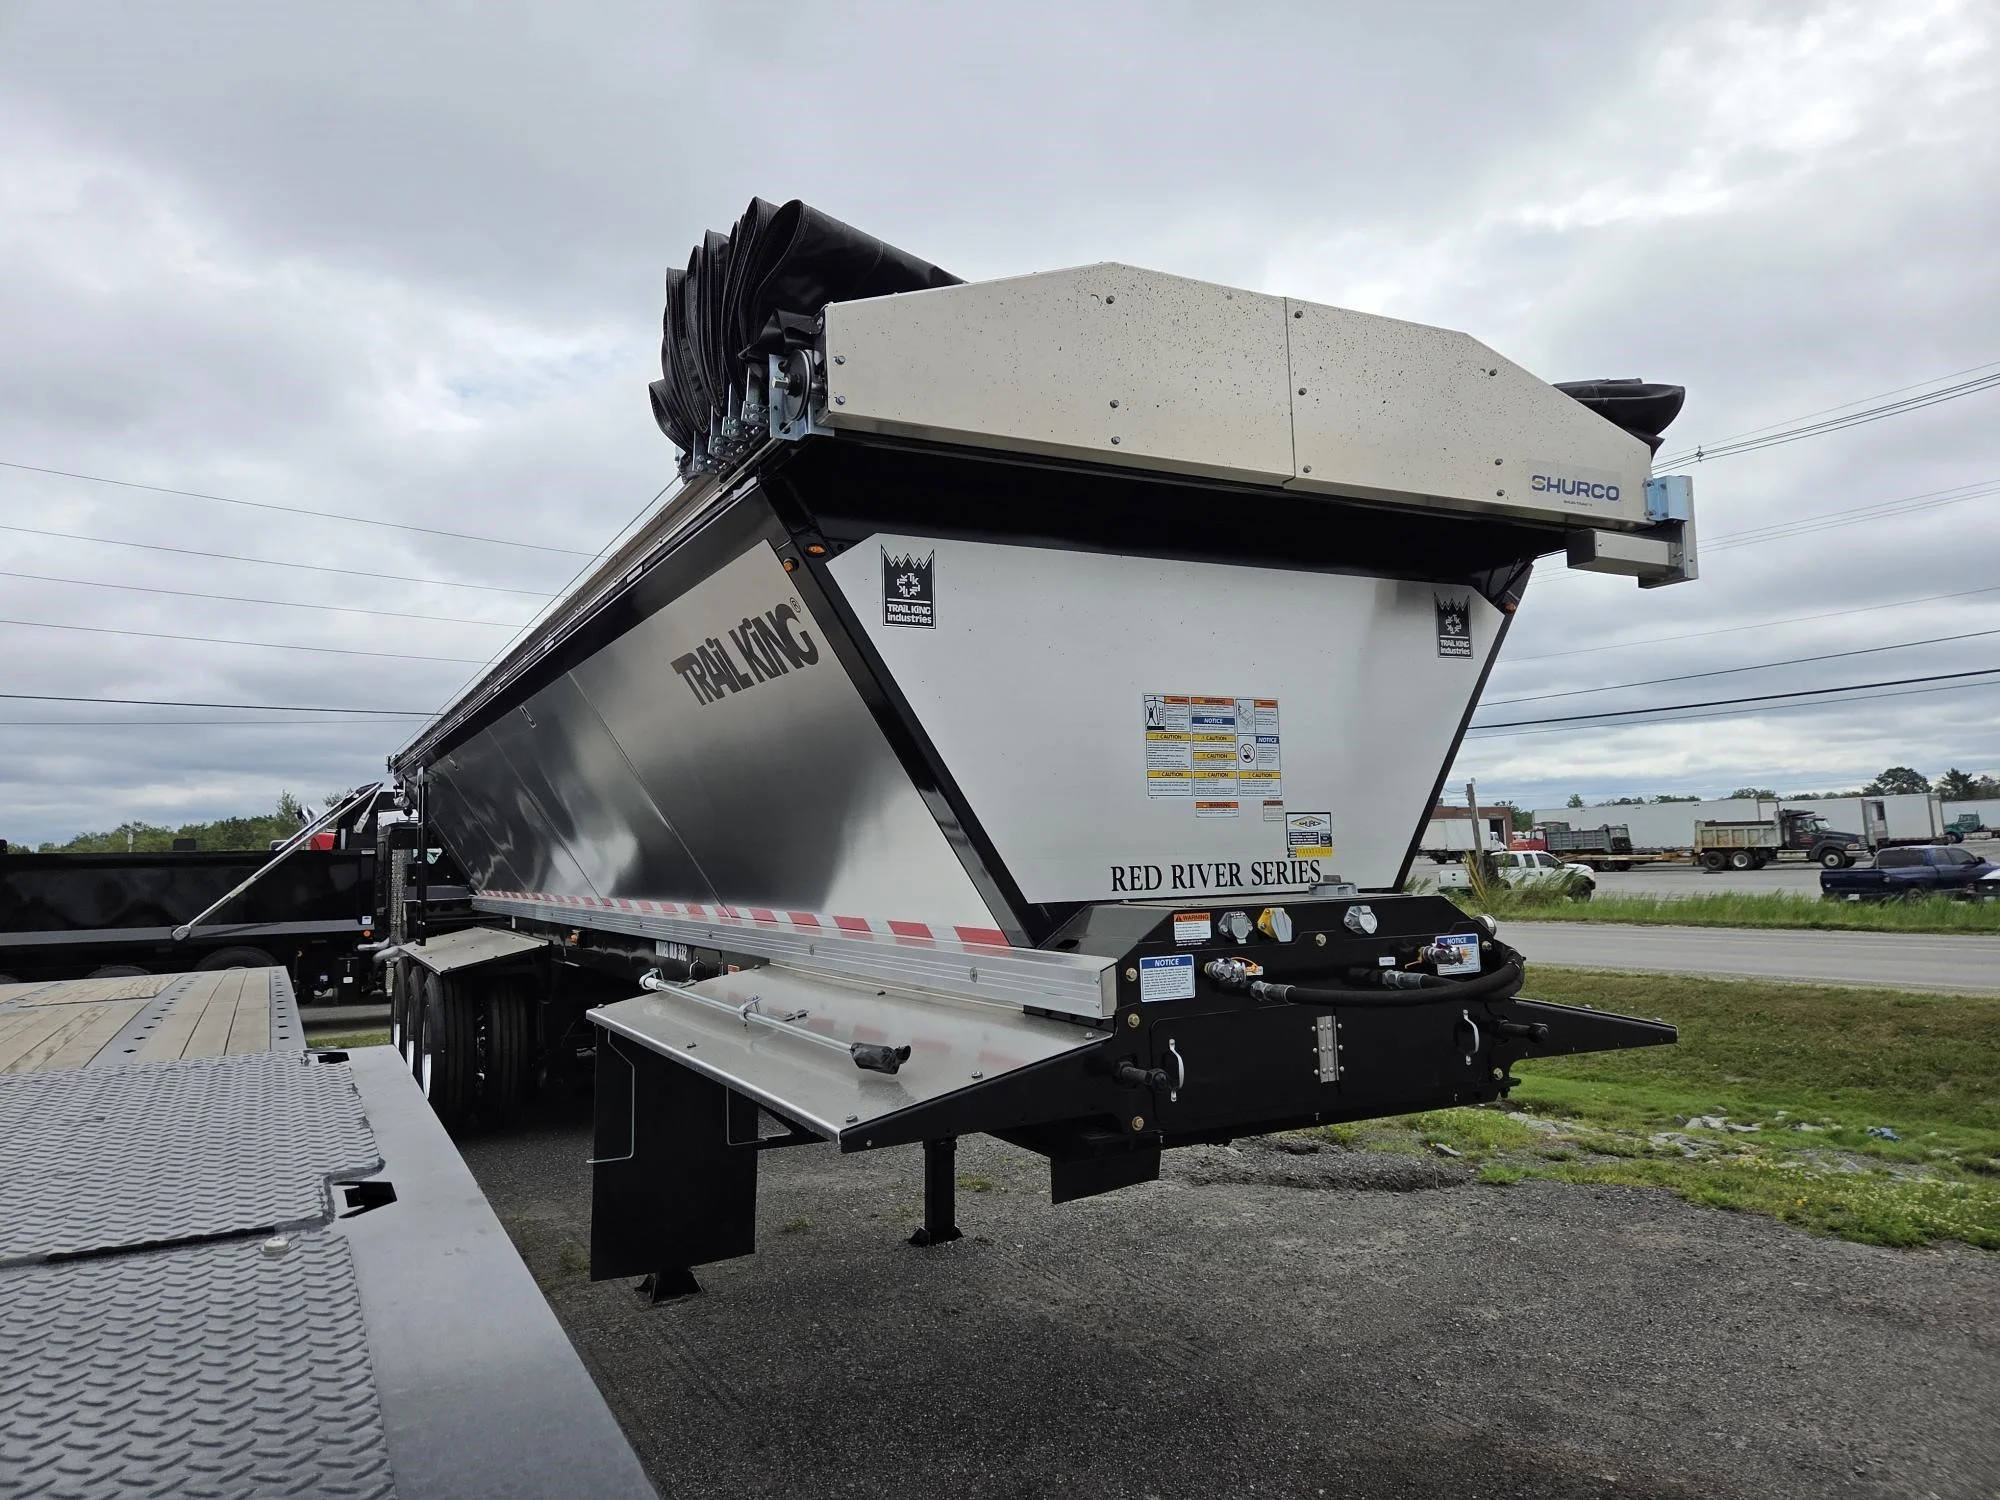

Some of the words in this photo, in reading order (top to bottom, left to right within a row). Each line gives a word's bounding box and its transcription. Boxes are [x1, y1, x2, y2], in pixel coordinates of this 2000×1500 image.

[1532, 474, 1620, 500] SHURCO
[888, 612, 932, 624] industries
[1110, 865, 1163, 892] RED
[1171, 862, 1244, 890] RIVER
[1251, 859, 1321, 886] SERIES
[1154, 958, 1180, 966] NOTICE
